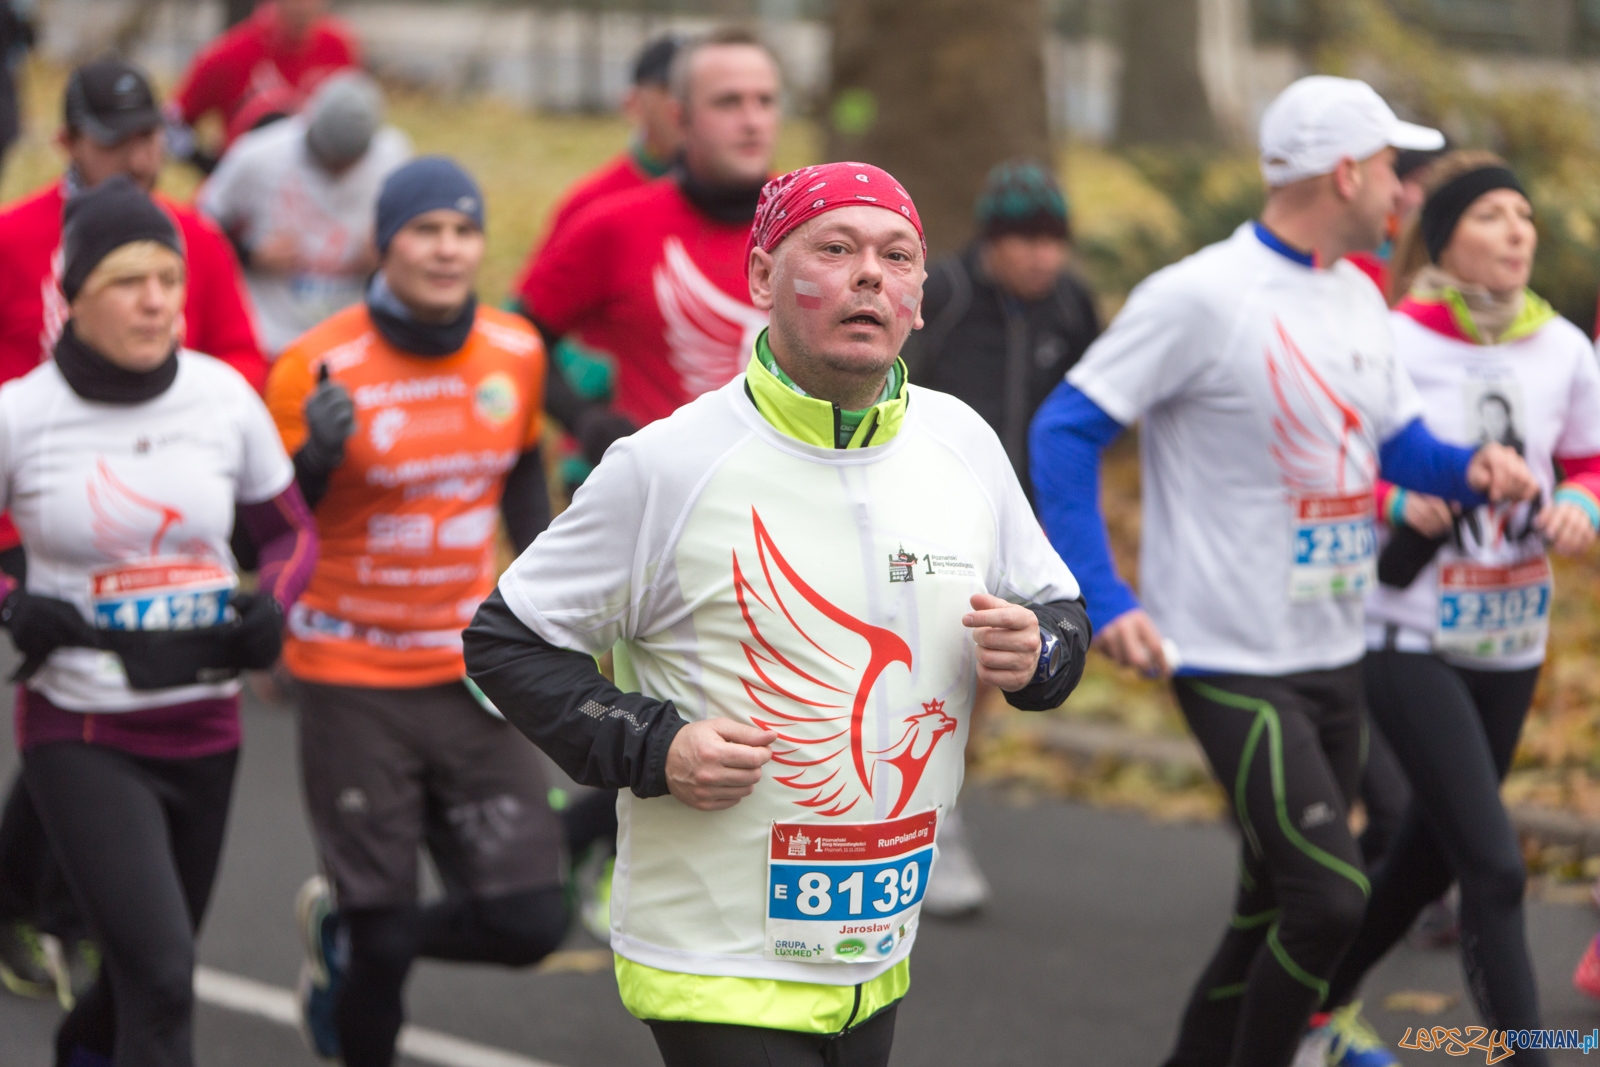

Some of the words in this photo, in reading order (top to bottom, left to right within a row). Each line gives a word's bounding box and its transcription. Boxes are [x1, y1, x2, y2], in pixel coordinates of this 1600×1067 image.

[923, 554, 935, 574] 1
[814, 837, 823, 852] 1
[878, 827, 929, 848] RunPoland.org
[774, 884, 788, 900] E
[796, 861, 919, 916] 8139
[839, 923, 891, 934] Jarosław
[775, 940, 807, 949] GRUPA
[775, 948, 812, 958] LUXMED
